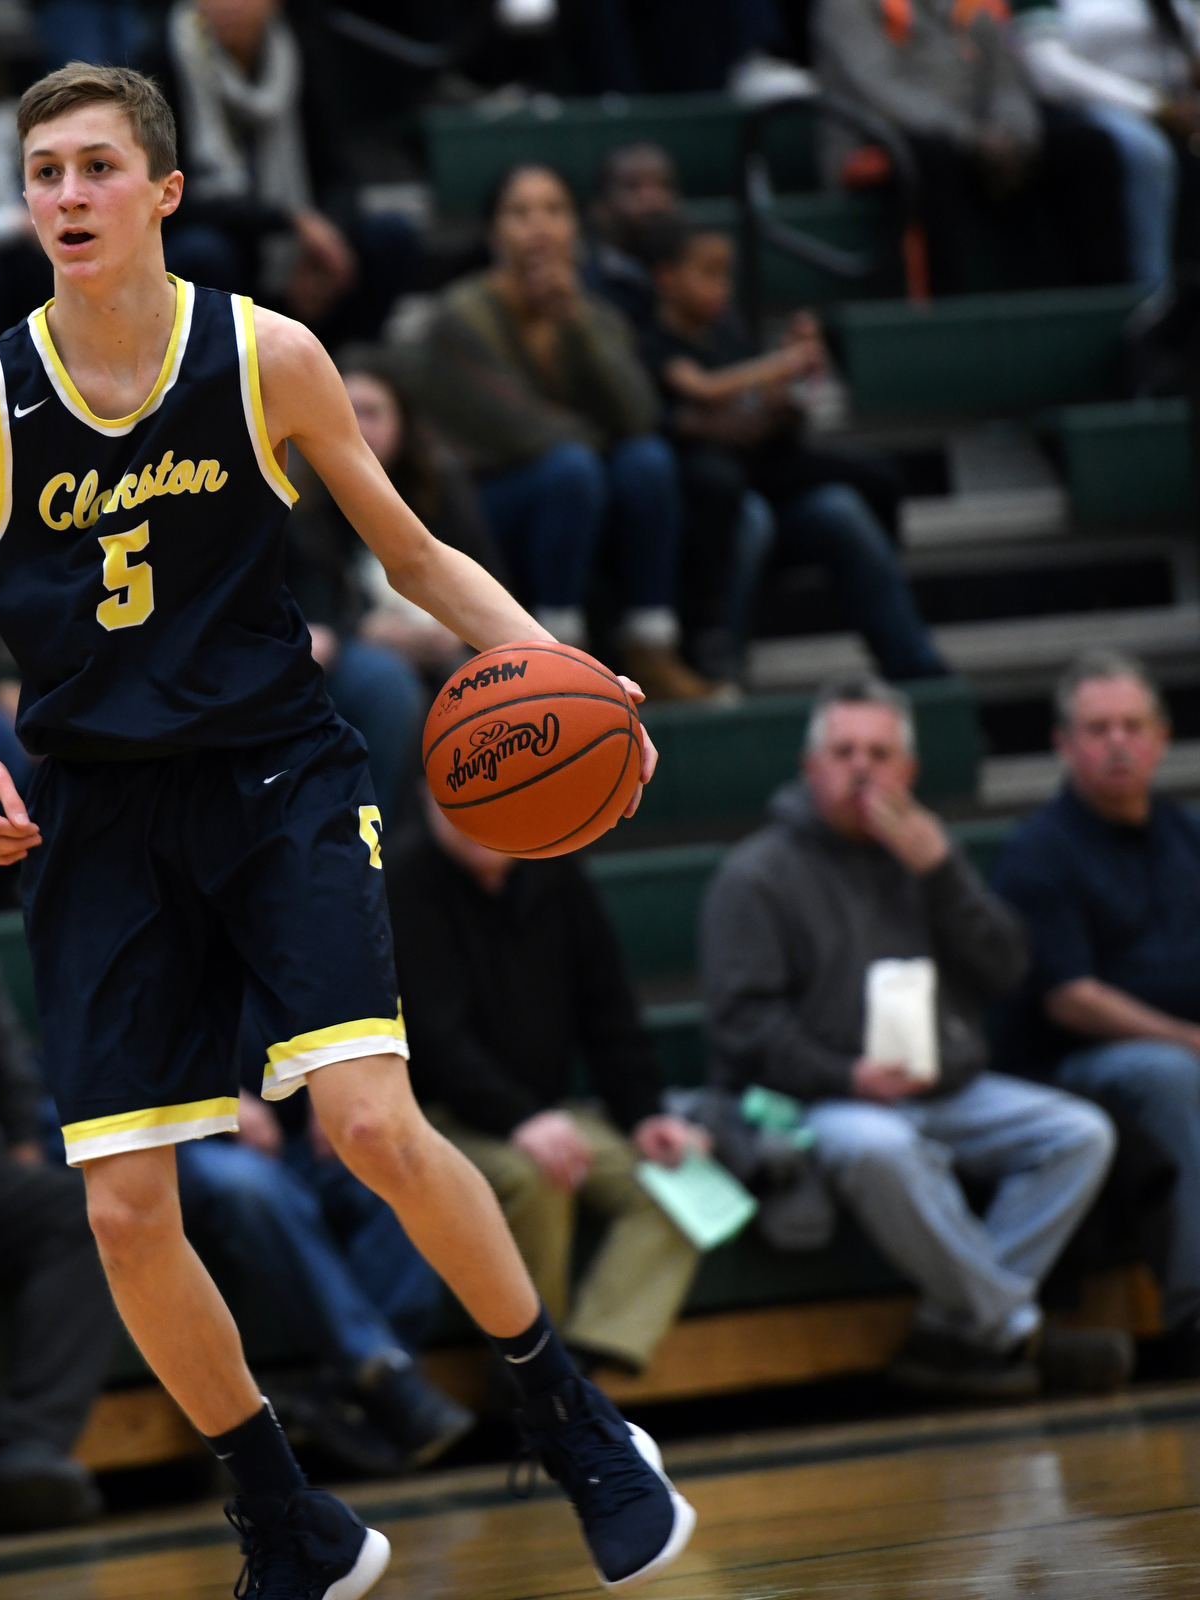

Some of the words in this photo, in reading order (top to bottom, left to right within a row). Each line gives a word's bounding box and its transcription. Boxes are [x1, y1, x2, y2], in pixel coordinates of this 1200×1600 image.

[38, 450, 228, 530] Clakston
[96, 520, 154, 631] 5
[447, 660, 528, 701] MHSAA
[446, 713, 559, 792] Rawlings
